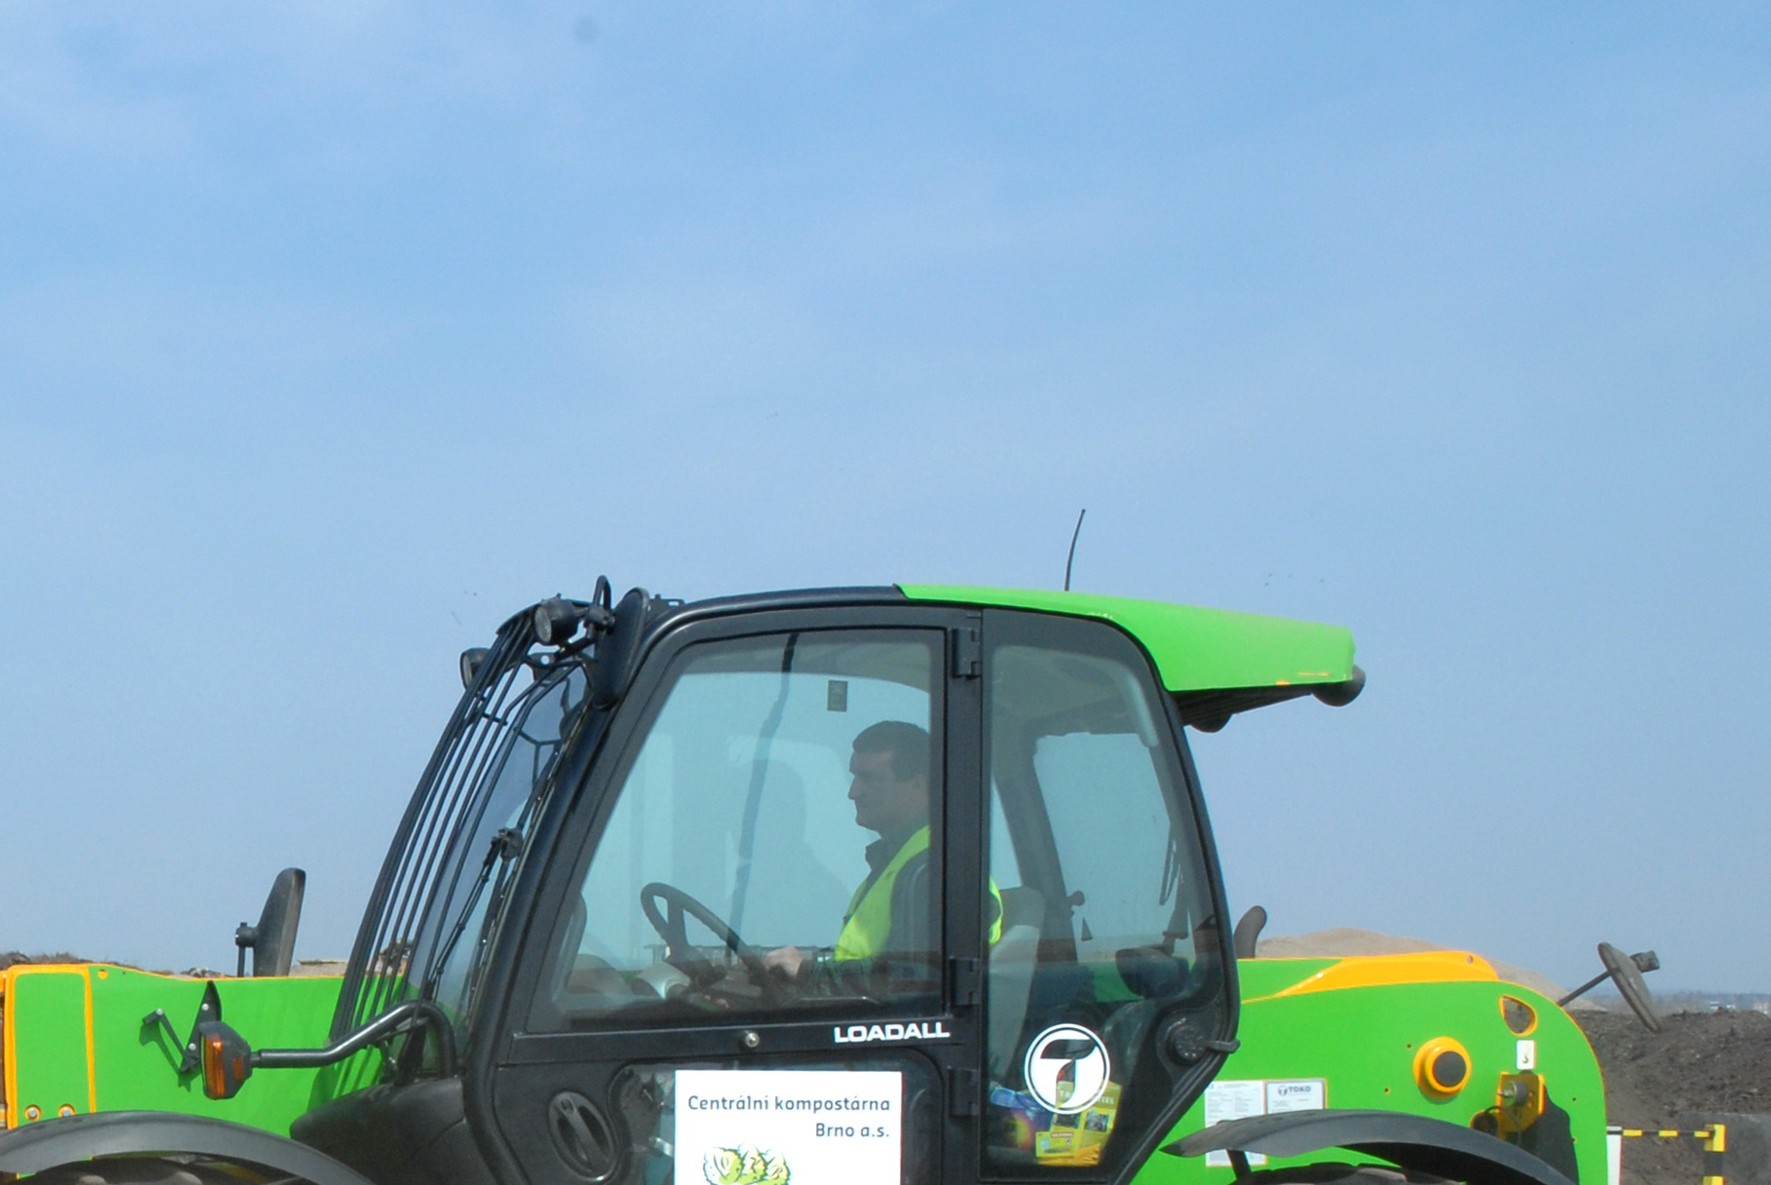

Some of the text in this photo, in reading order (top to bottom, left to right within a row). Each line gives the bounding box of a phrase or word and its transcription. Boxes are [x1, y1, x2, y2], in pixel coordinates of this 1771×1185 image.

[834, 1022, 950, 1043] LOADALL
[688, 1095, 890, 1114] Centrální kompostárna
[815, 1123, 890, 1138] Brno a.s.
